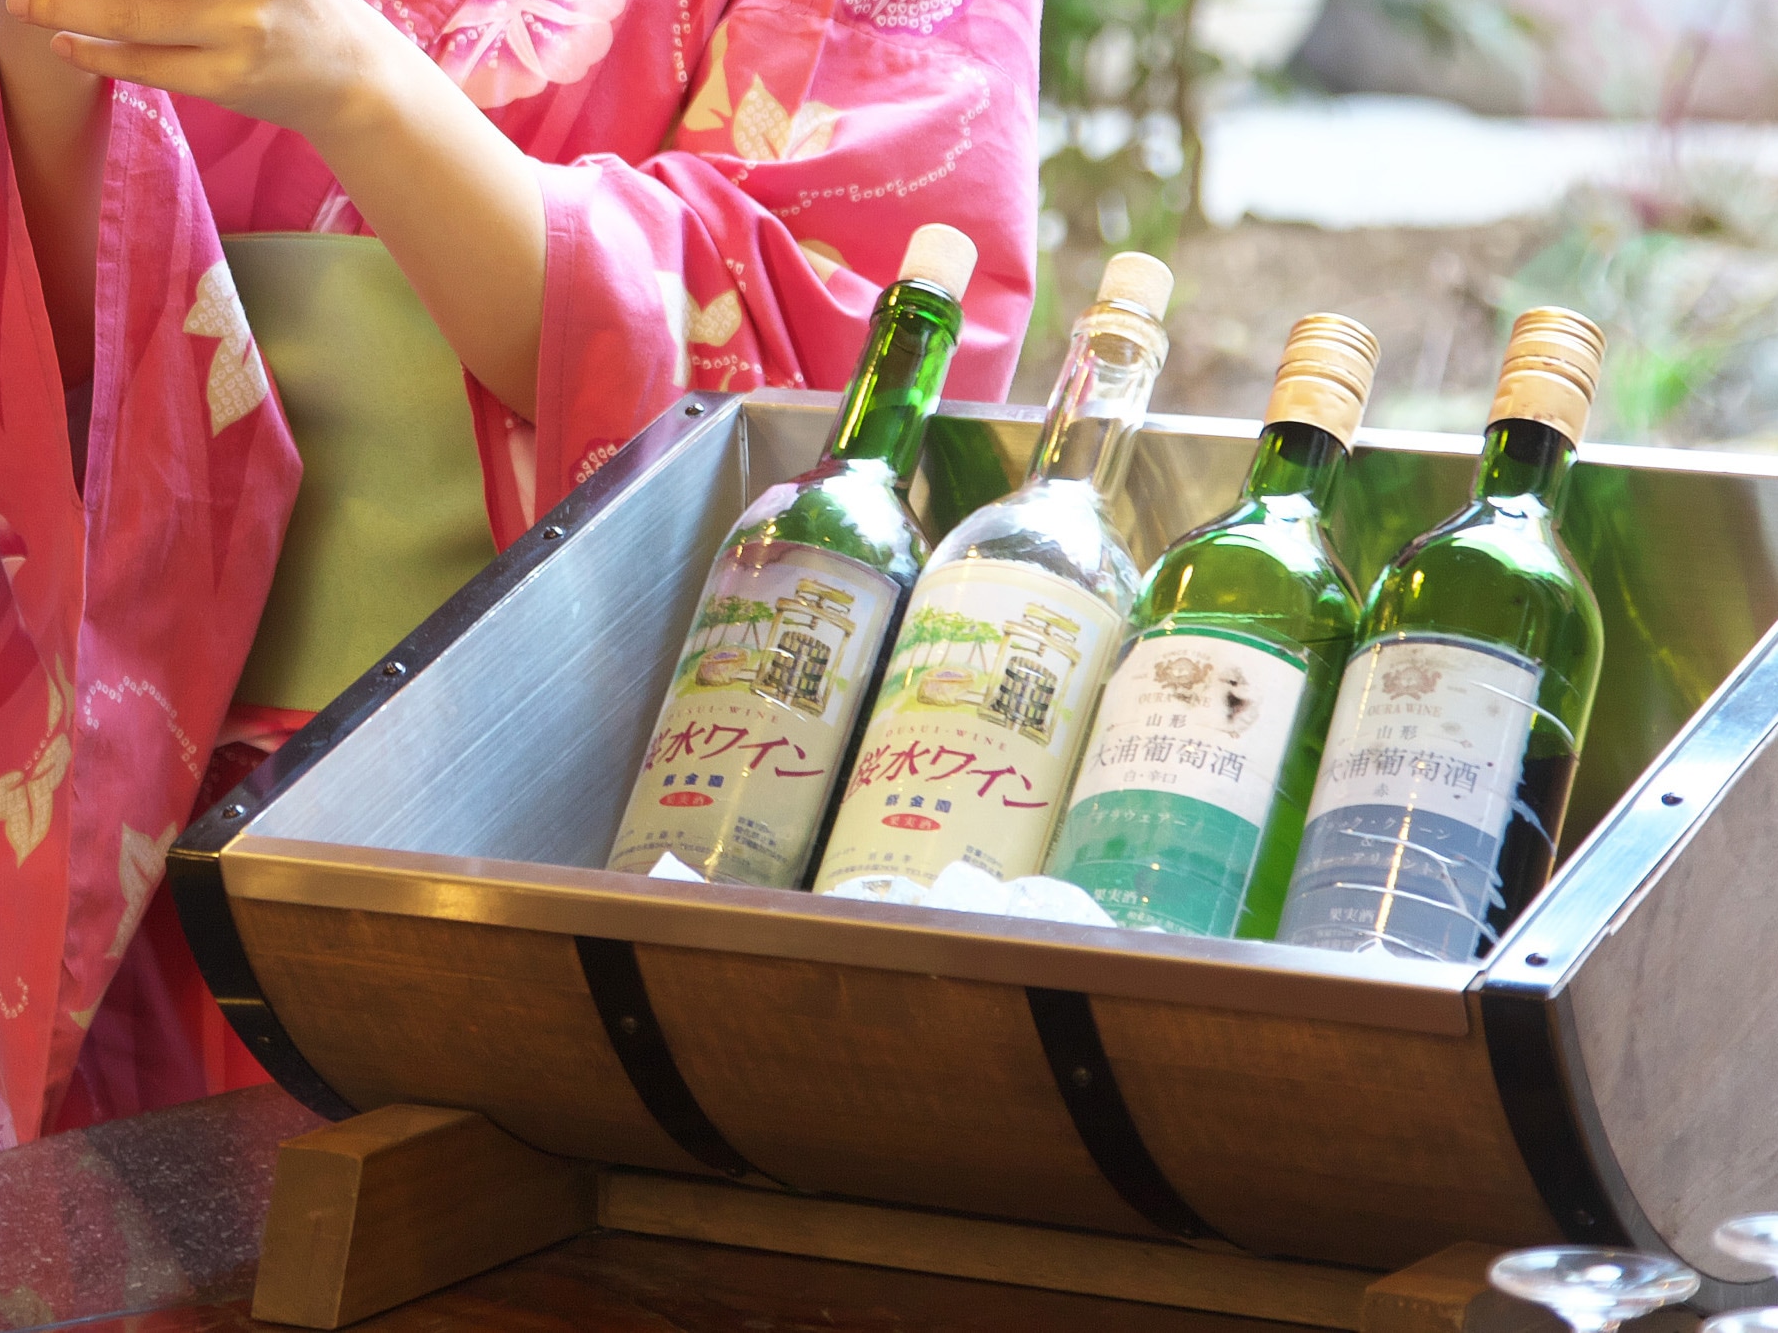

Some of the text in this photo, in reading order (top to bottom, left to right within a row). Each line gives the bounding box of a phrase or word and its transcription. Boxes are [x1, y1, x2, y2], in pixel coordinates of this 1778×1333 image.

[1405, 702, 1443, 719] WINE
[1145, 713, 1188, 729] 山形
[884, 725, 1008, 753] OUSUI-WINE
[1375, 724, 1419, 741] 山形
[1090, 733, 1247, 784] 大浦葡萄酒
[1123, 769, 1178, 785] 白・辛口
[1325, 746, 1481, 795] 大浦葡萄酒
[1315, 815, 1451, 841] ラック・クーン
[1093, 887, 1139, 906] 果実酒
[1329, 907, 1376, 924] 果実酒
